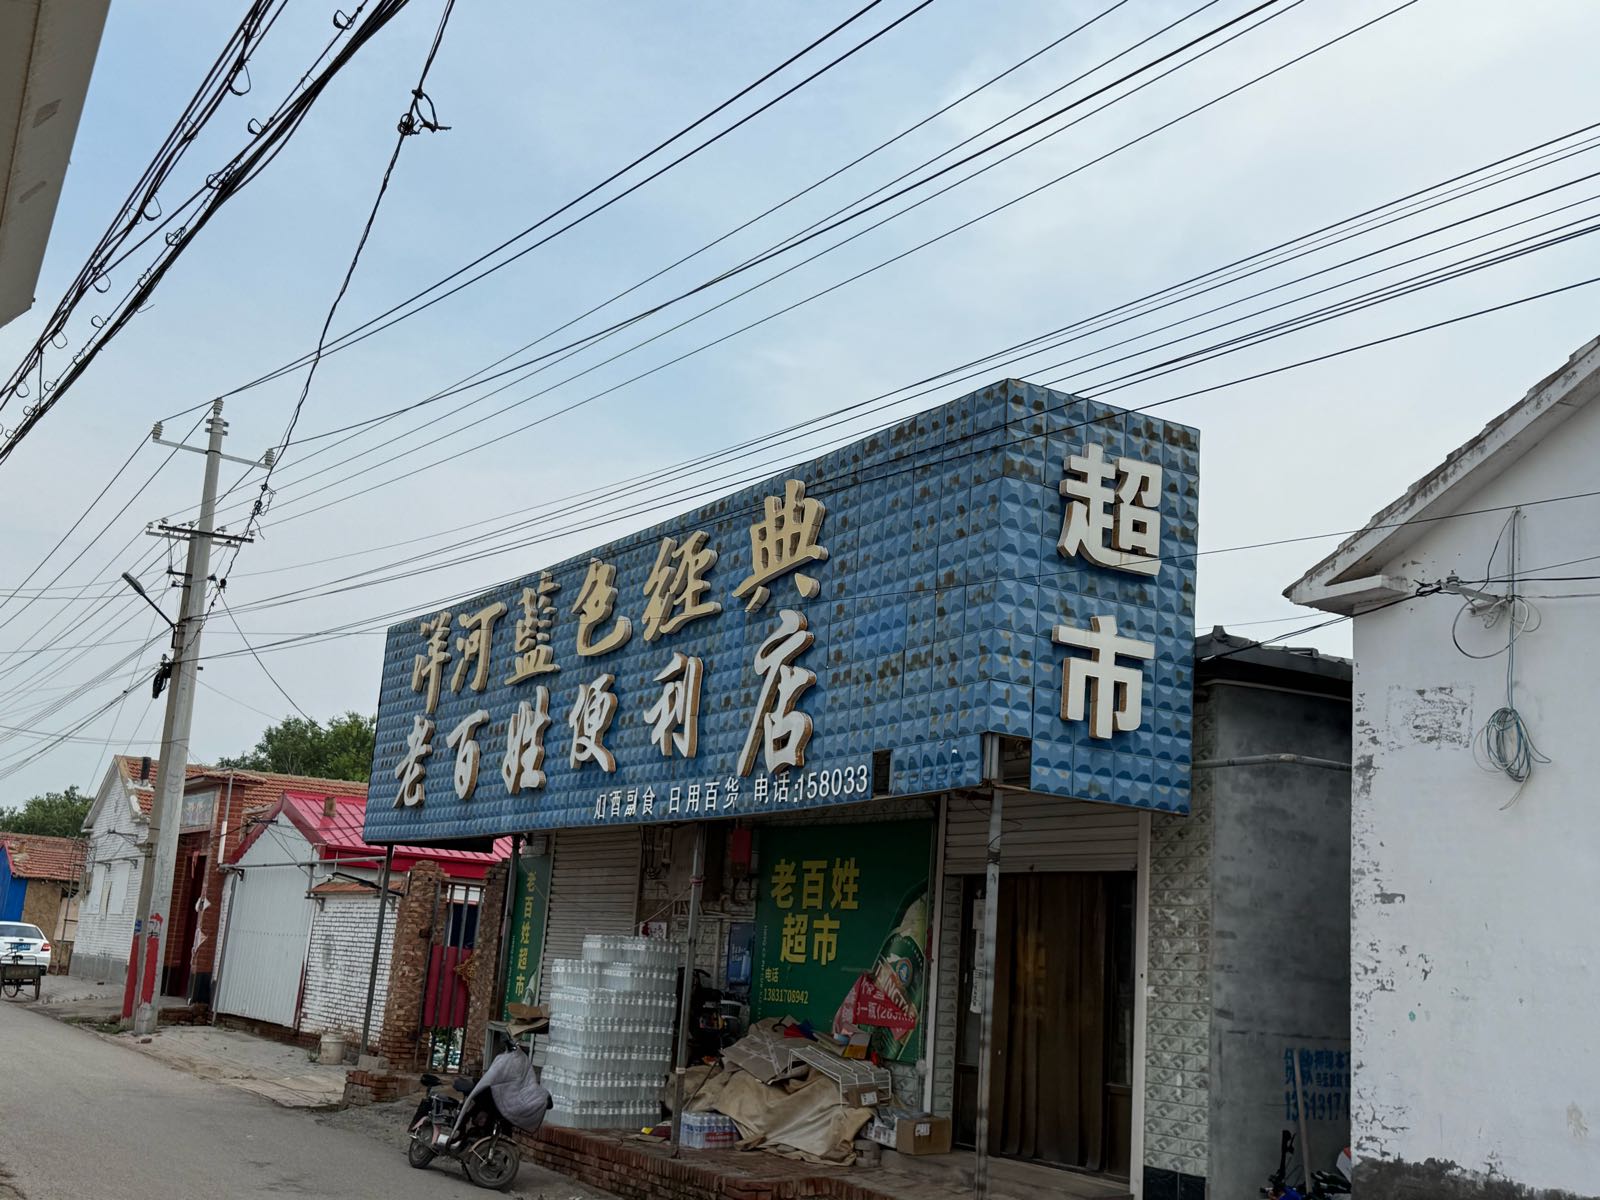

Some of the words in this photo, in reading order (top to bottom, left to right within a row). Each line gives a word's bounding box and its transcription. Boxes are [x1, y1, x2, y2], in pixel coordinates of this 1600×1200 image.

[1051, 442, 1163, 740] 超市
[393, 609, 817, 808] 老百姓便利店
[669, 777, 739, 814] 日用百货
[771, 857, 860, 910] 老百姓
[515, 872, 537, 998] 老百姓超市
[780, 913, 841, 965] 超市
[765, 968, 780, 983] 电话
